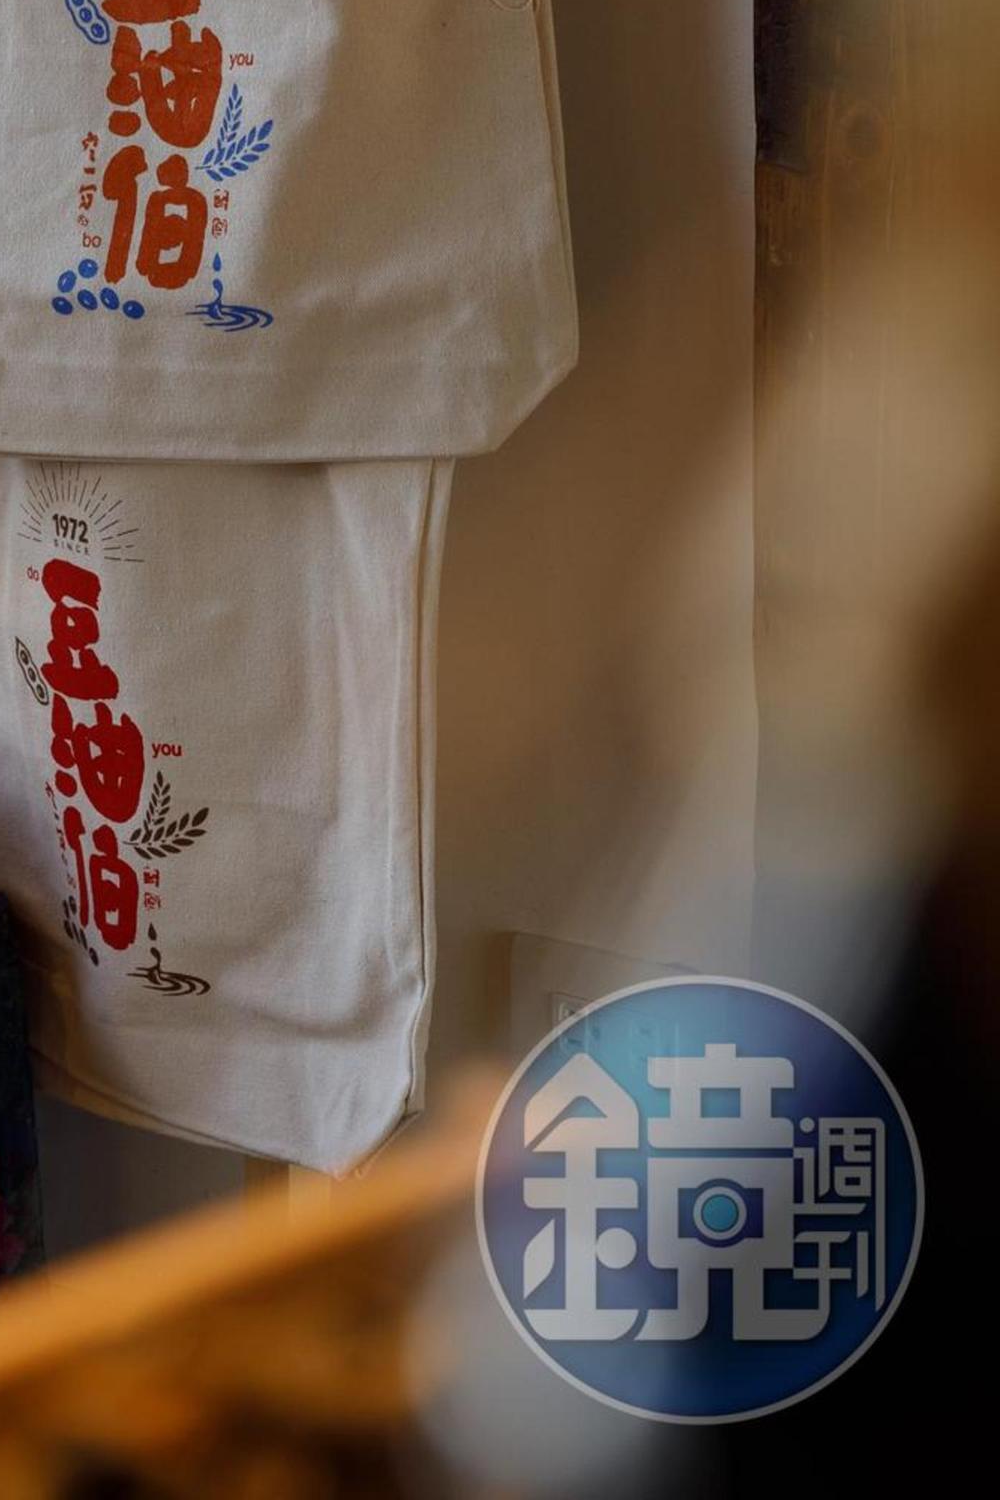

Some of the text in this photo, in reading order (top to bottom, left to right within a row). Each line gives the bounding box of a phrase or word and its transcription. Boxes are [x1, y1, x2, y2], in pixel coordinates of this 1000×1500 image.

[229, 53, 254, 69] you
[82, 232, 102, 248] bo
[52, 513, 89, 544] 1972
[27, 566, 40, 582] do
[40, 558, 145, 951] 豆油伯
[151, 742, 182, 758] you
